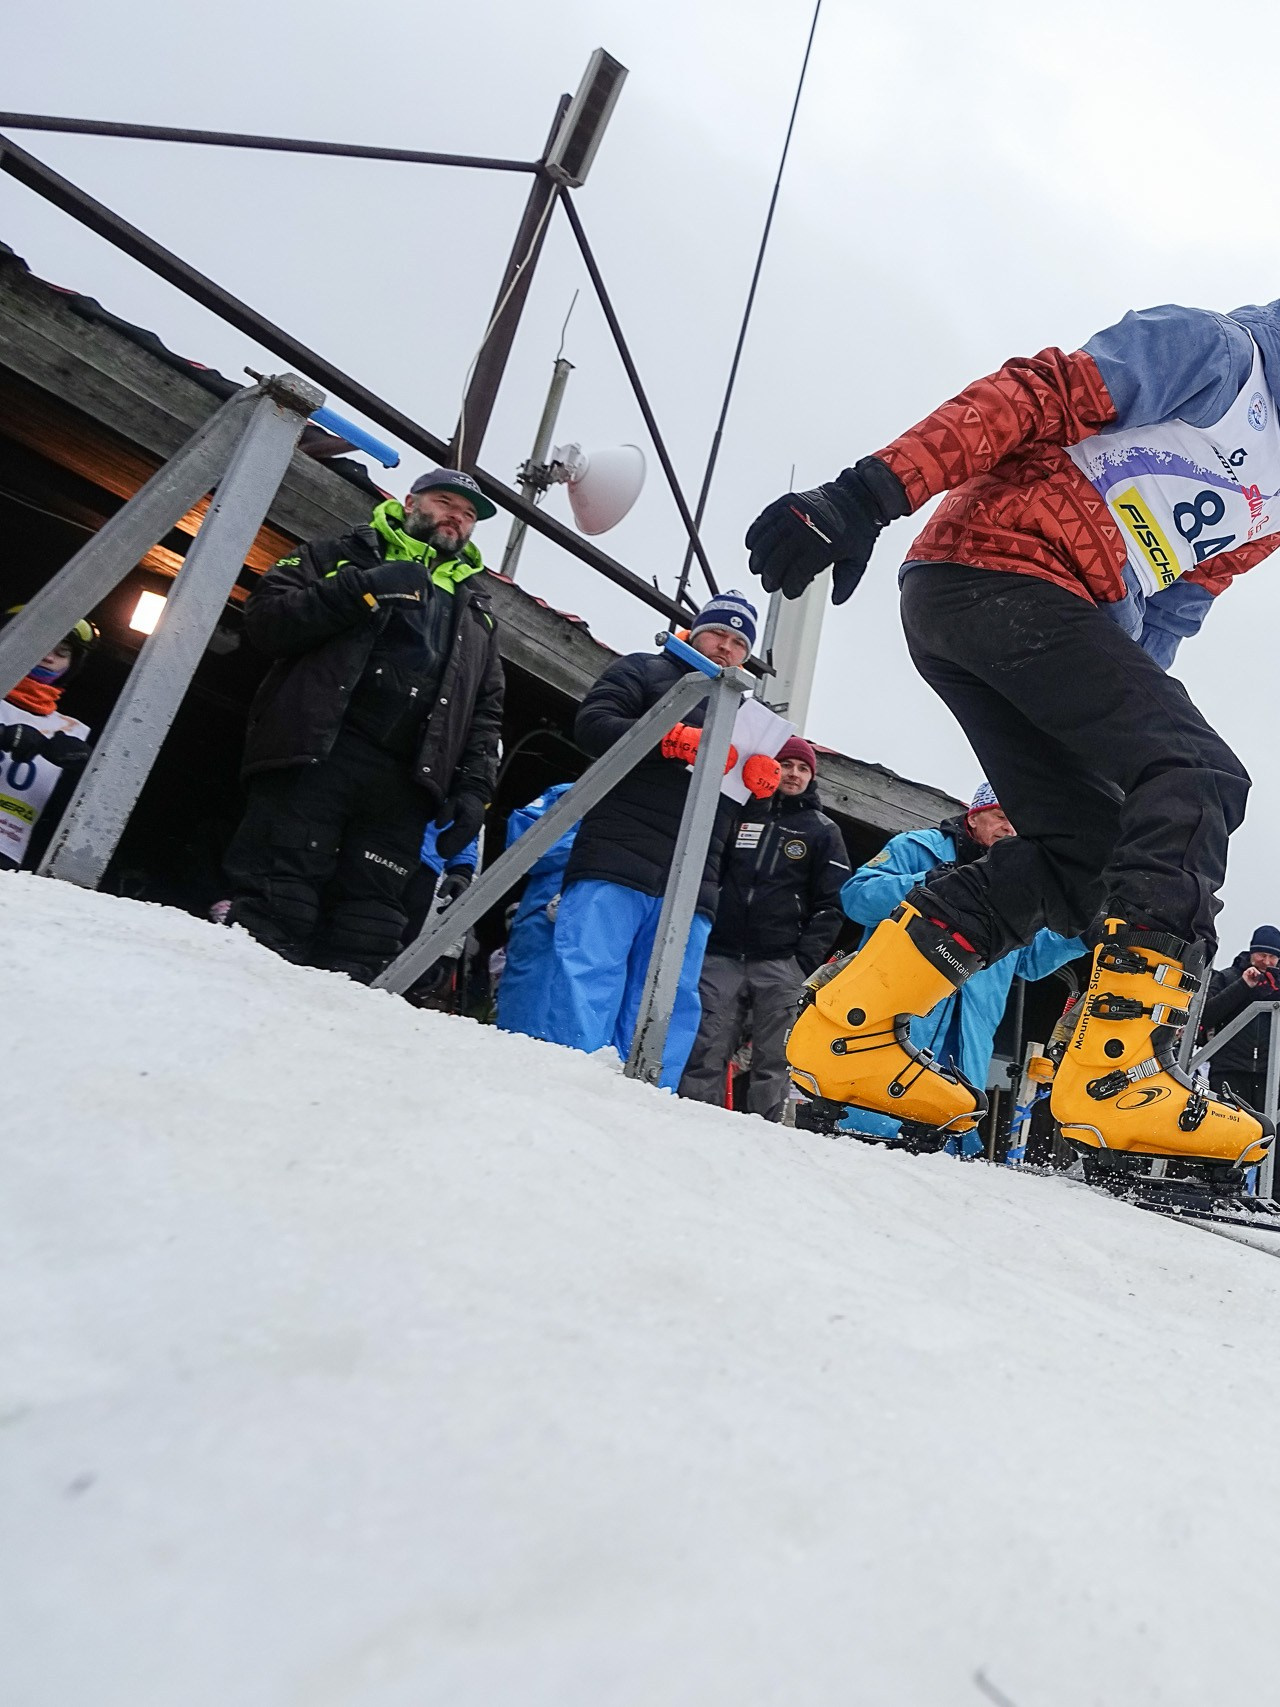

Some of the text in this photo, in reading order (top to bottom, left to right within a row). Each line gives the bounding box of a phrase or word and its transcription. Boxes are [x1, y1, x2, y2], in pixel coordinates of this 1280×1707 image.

[1119, 504, 1176, 587] FISCHE
[1173, 490, 1236, 562] 84
[935, 943, 970, 979] Mountain
[1089, 964, 1103, 990] Slop
